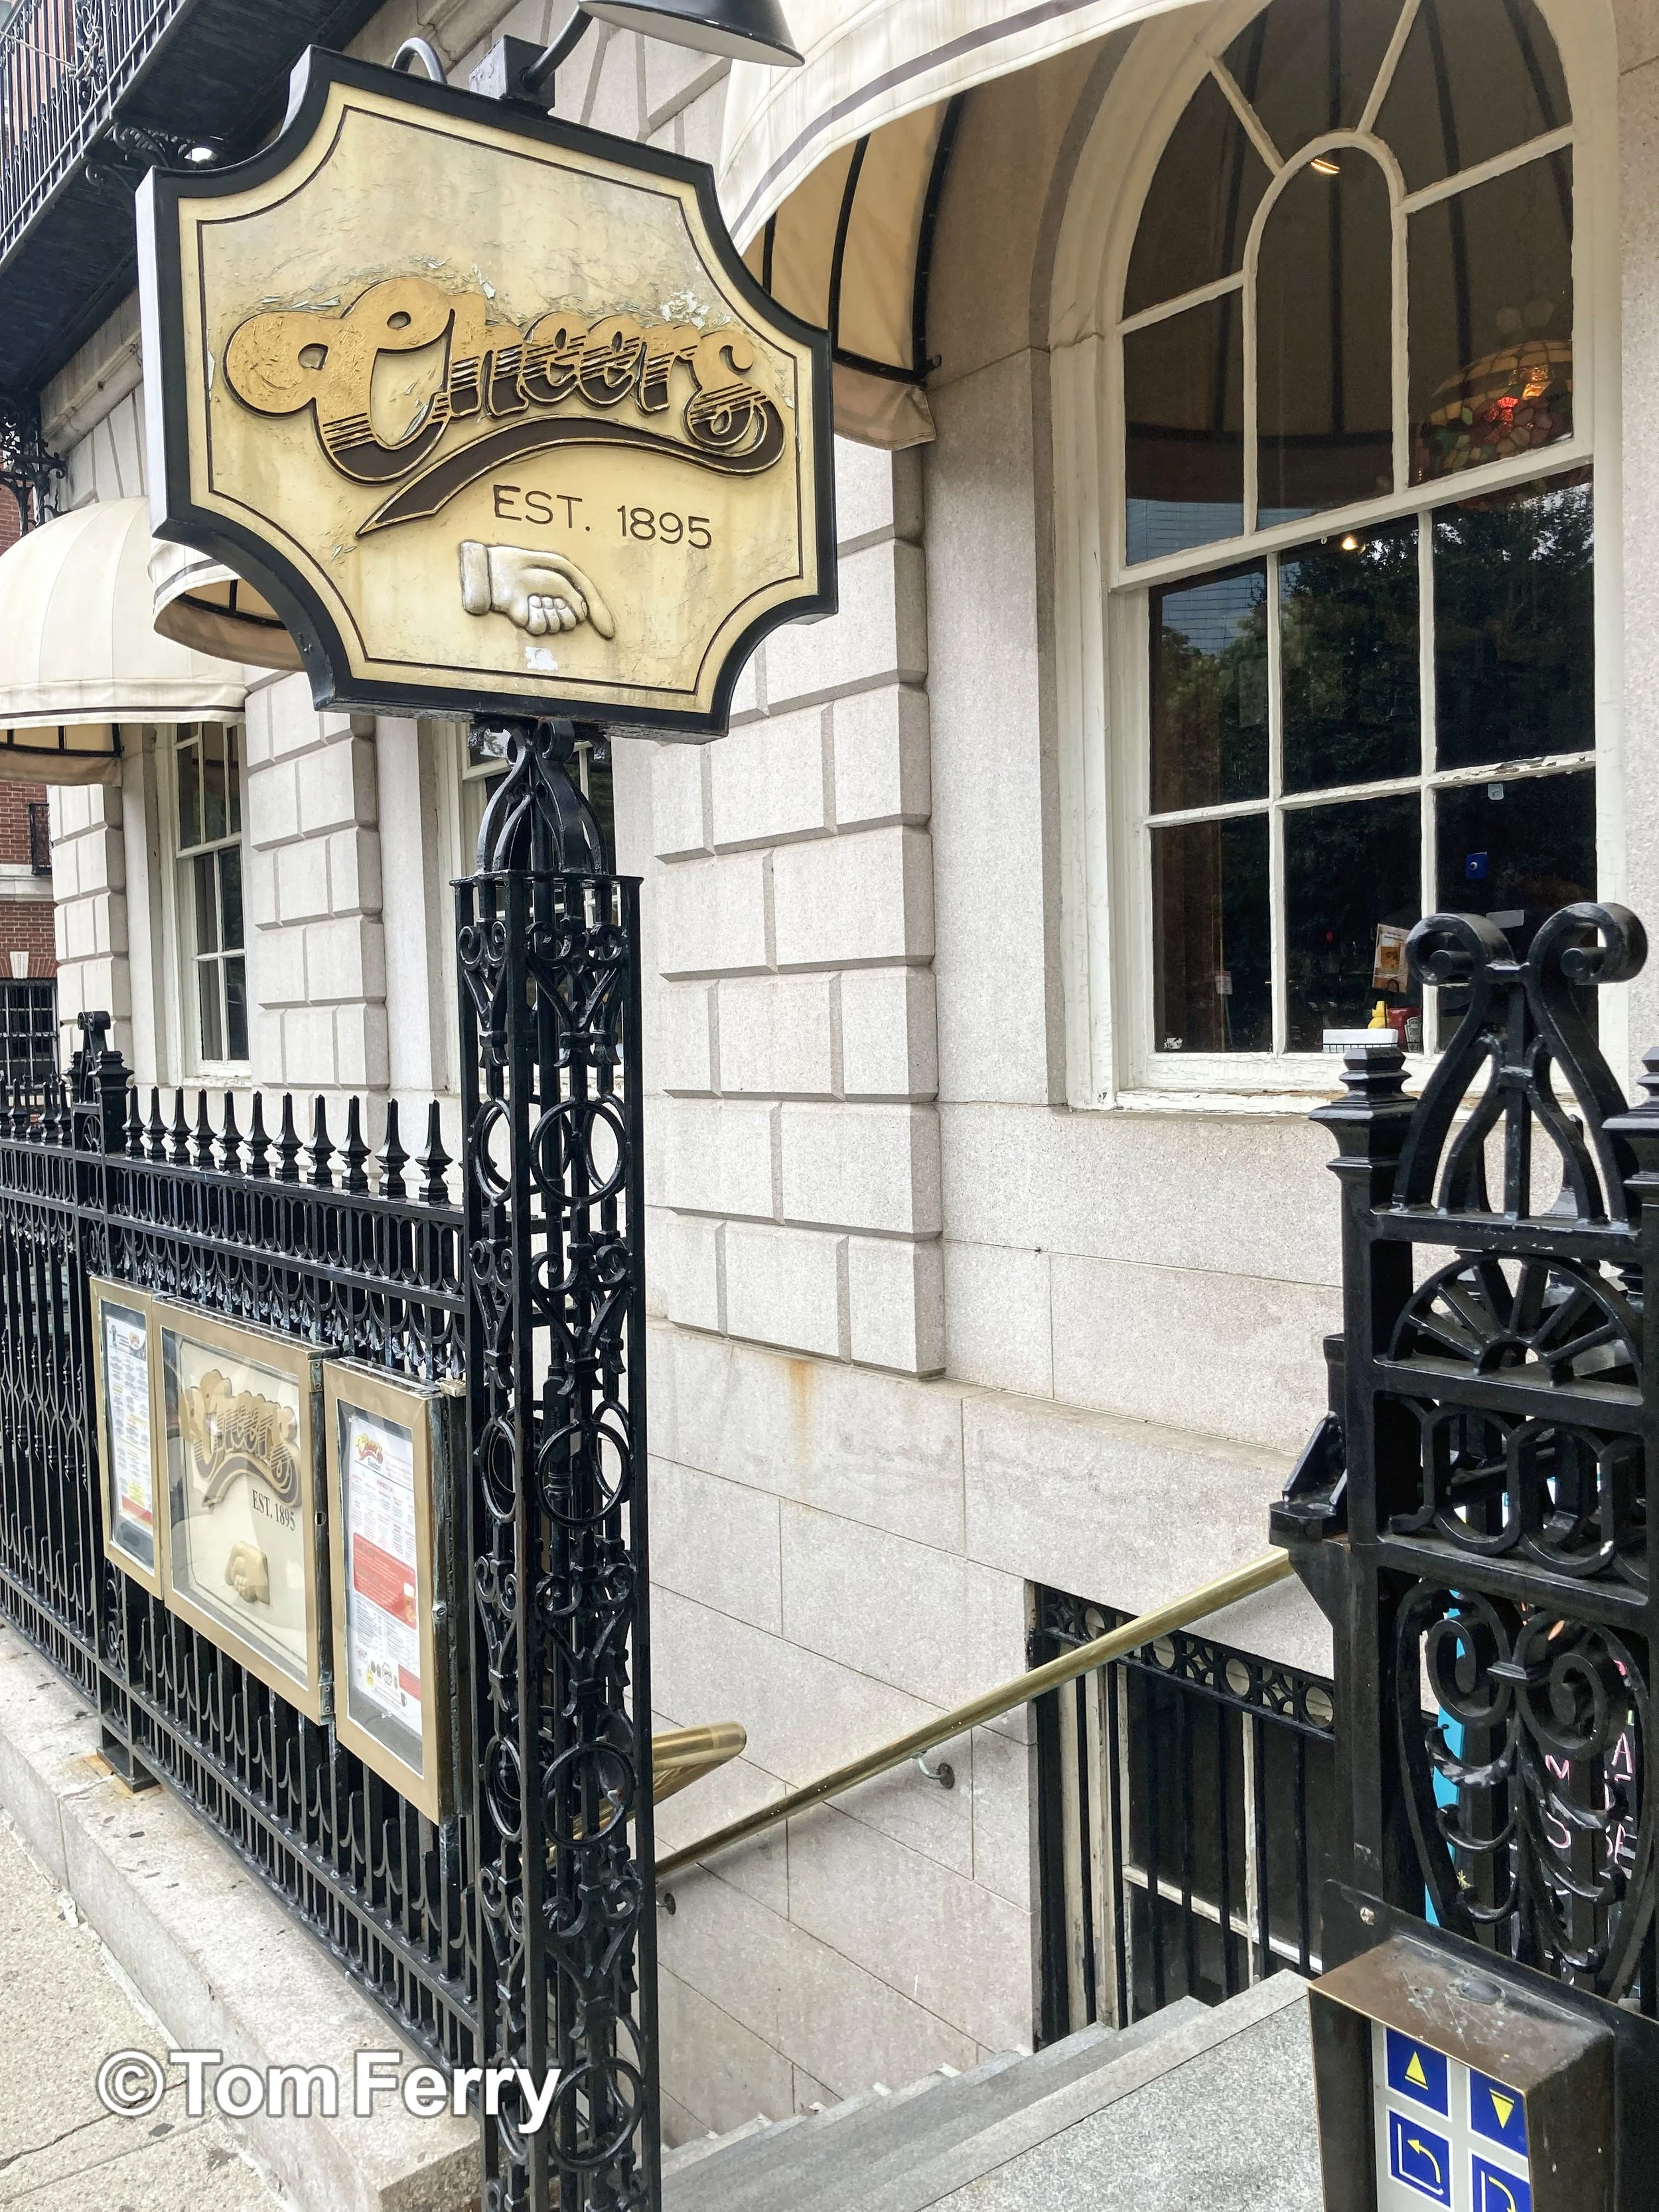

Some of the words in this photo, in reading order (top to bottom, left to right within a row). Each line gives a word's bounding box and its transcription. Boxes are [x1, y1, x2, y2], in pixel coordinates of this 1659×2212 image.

[224, 276, 786, 536] Cheers
[494, 485, 592, 534] EST.
[617, 503, 713, 550] 1895
[179, 1368, 302, 1508] Cheers
[252, 1489, 273, 1519] EST.
[275, 1503, 296, 1531] 1895
